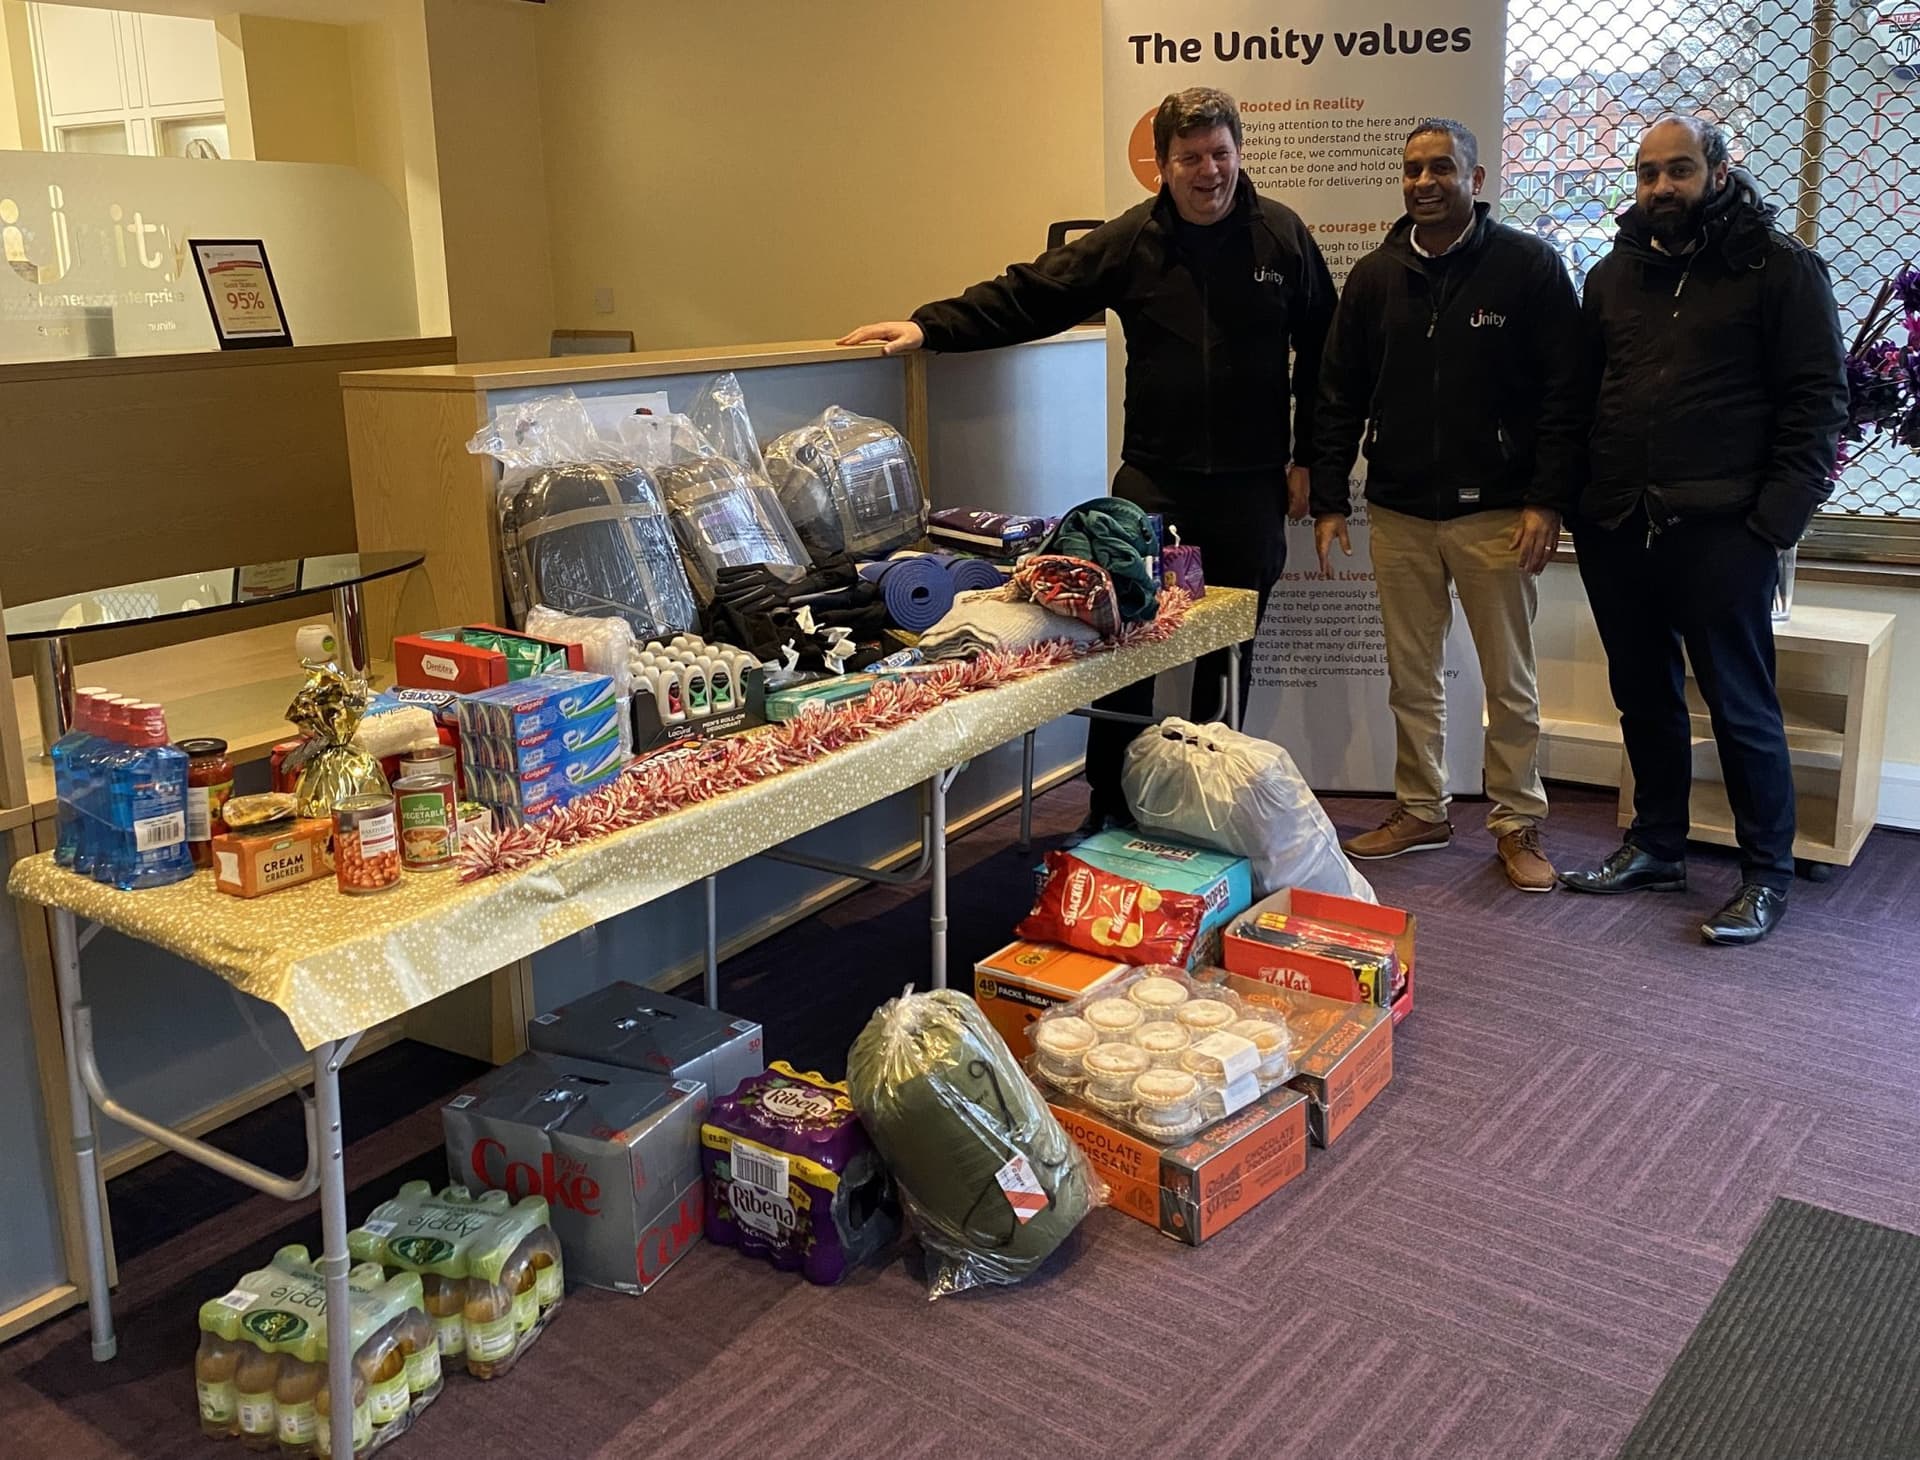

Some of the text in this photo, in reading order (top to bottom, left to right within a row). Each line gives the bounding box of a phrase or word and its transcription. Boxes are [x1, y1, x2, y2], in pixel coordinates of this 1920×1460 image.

[1128, 23, 1472, 66] The Unity values
[1240, 97, 1365, 113] Rooted in Reality
[1240, 121, 1275, 133] Paying
[1278, 119, 1329, 131] attention
[1331, 119, 1343, 129] to
[1345, 118, 1364, 128] the
[1366, 117, 1392, 128] here
[1394, 116, 1415, 127] and
[1283, 134, 1295, 145] to
[1298, 132, 1361, 145] understand
[1363, 132, 1382, 142] the
[1384, 133, 1408, 142] stru
[1279, 149, 1307, 161] face,
[1309, 150, 1325, 159] we
[1327, 146, 1404, 159] communicate
[1268, 165, 1288, 175] can
[1290, 163, 1304, 174] be
[1307, 162, 1334, 173] done
[1337, 162, 1358, 172] and
[1360, 160, 1386, 171] hold
[1308, 177, 1324, 187] for
[1326, 175, 1382, 188] delivering
[1385, 177, 1400, 185] on
[1318, 222, 1377, 235] courage
[1347, 241, 1360, 251] to
[1254, 266, 1285, 286] Unity
[226, 291, 265, 310] 95%
[1470, 308, 1507, 328] Unity
[1309, 588, 1367, 600] generously
[1283, 602, 1295, 611] to
[1296, 602, 1321, 613] help
[1322, 603, 1343, 612] one
[1344, 602, 1382, 612] anothe
[1262, 614, 1312, 626] ffectively
[1314, 615, 1355, 625] support
[1279, 629, 1313, 638] across
[1315, 628, 1329, 637] all
[1331, 628, 1342, 637] of
[1344, 629, 1362, 637] our
[1292, 641, 1314, 650] that
[1316, 641, 1345, 651] many
[1272, 653, 1291, 662] and
[1293, 654, 1322, 664] every
[1324, 653, 1377, 663] individual
[1263, 665, 1288, 675] than
[1289, 666, 1308, 675] the
[1309, 666, 1385, 677] circumstances
[1258, 678, 1318, 688] themselves
[400, 691, 448, 702] COOKIES
[516, 698, 545, 713] Colgate
[521, 732, 549, 746] Colgate
[524, 765, 552, 780] Colgate
[403, 808, 445, 820] VEGETABLE
[527, 799, 555, 814] Colgate
[1128, 840, 1196, 860] PROPER
[263, 854, 304, 873] CREAM
[265, 865, 305, 882] CRACKERS
[1203, 879, 1229, 911] ROPER
[979, 979, 996, 991] 48
[768, 1089, 829, 1115] Ribena
[1245, 1126, 1296, 1164] CHOCOLATE
[1077, 1142, 1138, 1178] OISSANT
[471, 1137, 601, 1217] Coke
[733, 1185, 794, 1227] Ribena
[407, 1214, 483, 1239] Apple
